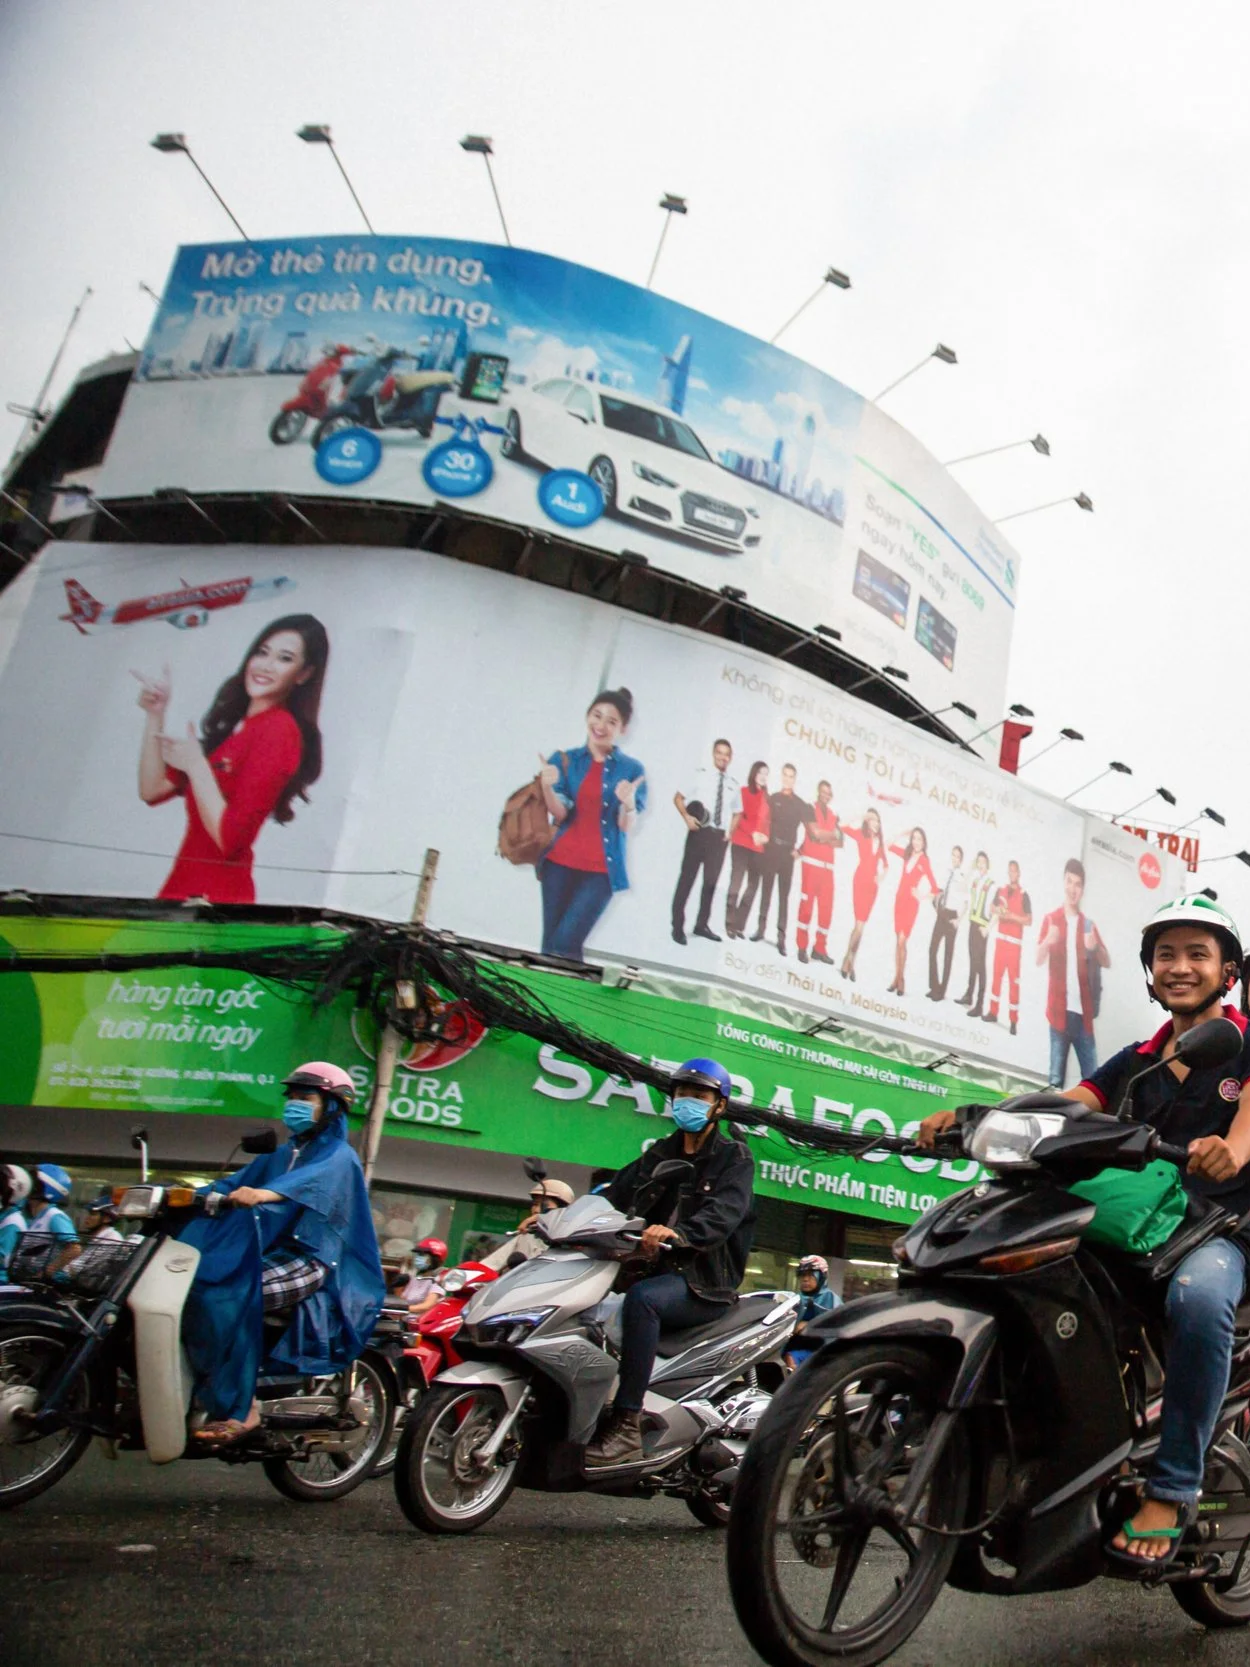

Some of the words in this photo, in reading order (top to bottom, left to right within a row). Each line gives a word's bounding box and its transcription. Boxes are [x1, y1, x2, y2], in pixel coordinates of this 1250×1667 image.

[785, 718, 857, 764] CHÚNG
[864, 752, 894, 782] TÔI
[929, 785, 998, 829] AIRASIA
[106, 978, 172, 1011] hàng
[174, 982, 215, 1012] tận
[215, 981, 266, 1014] gốc
[787, 971, 815, 993] Thái
[851, 992, 909, 1021] Malaysia
[198, 1020, 263, 1052] ngày
[751, 1032, 784, 1052] CÔNG
[785, 1043, 800, 1056] TY
[348, 1065, 464, 1103] STRA
[761, 1160, 809, 1189] THỰC
[814, 1173, 866, 1200] PHẨM
[869, 1183, 907, 1209] TIỆN
